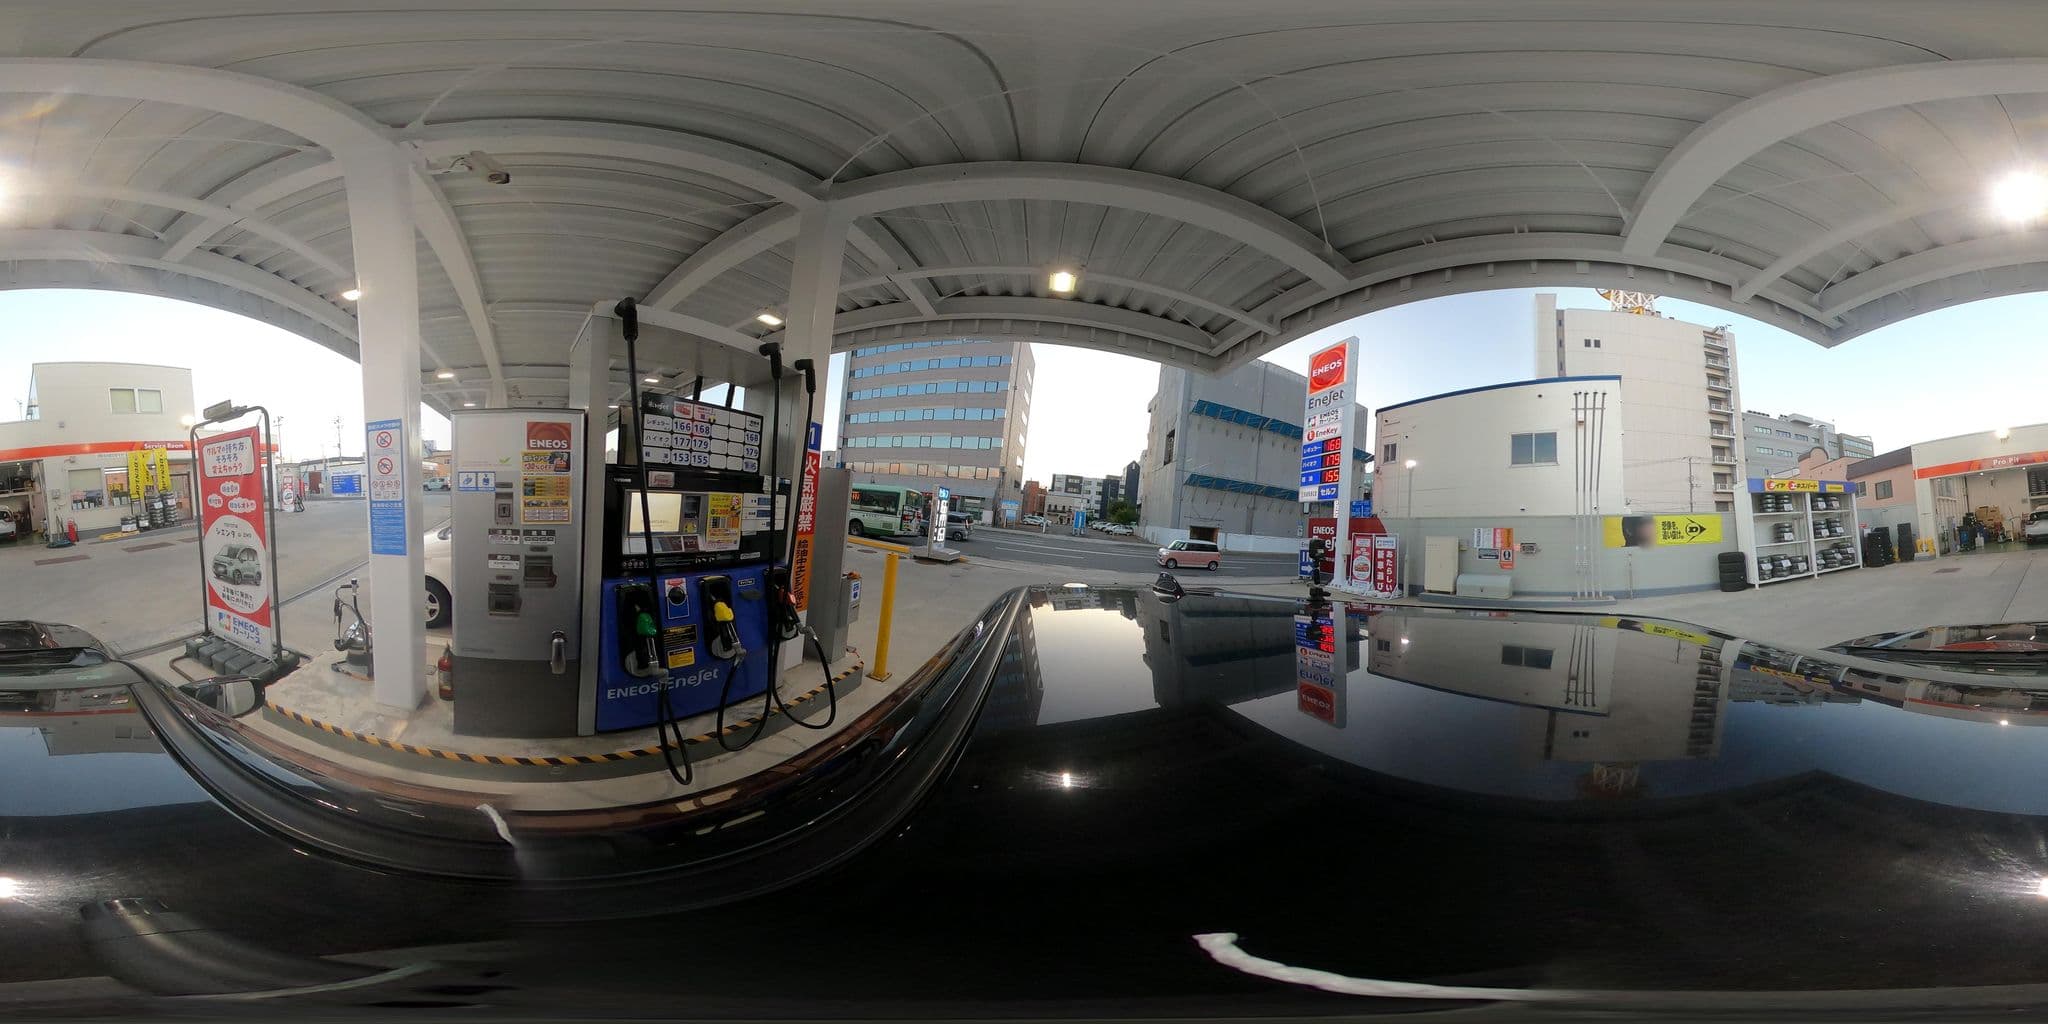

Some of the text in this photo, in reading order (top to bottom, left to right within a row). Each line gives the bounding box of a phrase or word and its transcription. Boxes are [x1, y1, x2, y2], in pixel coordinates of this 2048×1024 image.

[1312, 359, 1343, 377] ENEOS
[1308, 389, 1344, 409] EneJet
[1319, 409, 1339, 419] ENEOS
[674, 421, 710, 434] 166 168
[1315, 427, 1338, 438] EneKey
[529, 439, 568, 449] ENEOS
[673, 437, 708, 449] 177 179
[1326, 438, 1341, 450] 168
[673, 453, 708, 465] 153 155
[1325, 453, 1340, 466] 179
[1324, 470, 1339, 482] 155
[797, 455, 817, 532] 火気厳禁
[1319, 487, 1337, 496] セルフ
[1312, 526, 1335, 535] ENEOS
[232, 617, 260, 636] ENEOS
[233, 627, 262, 645] カーリース
[607, 668, 719, 700] ENEOS EneJet
